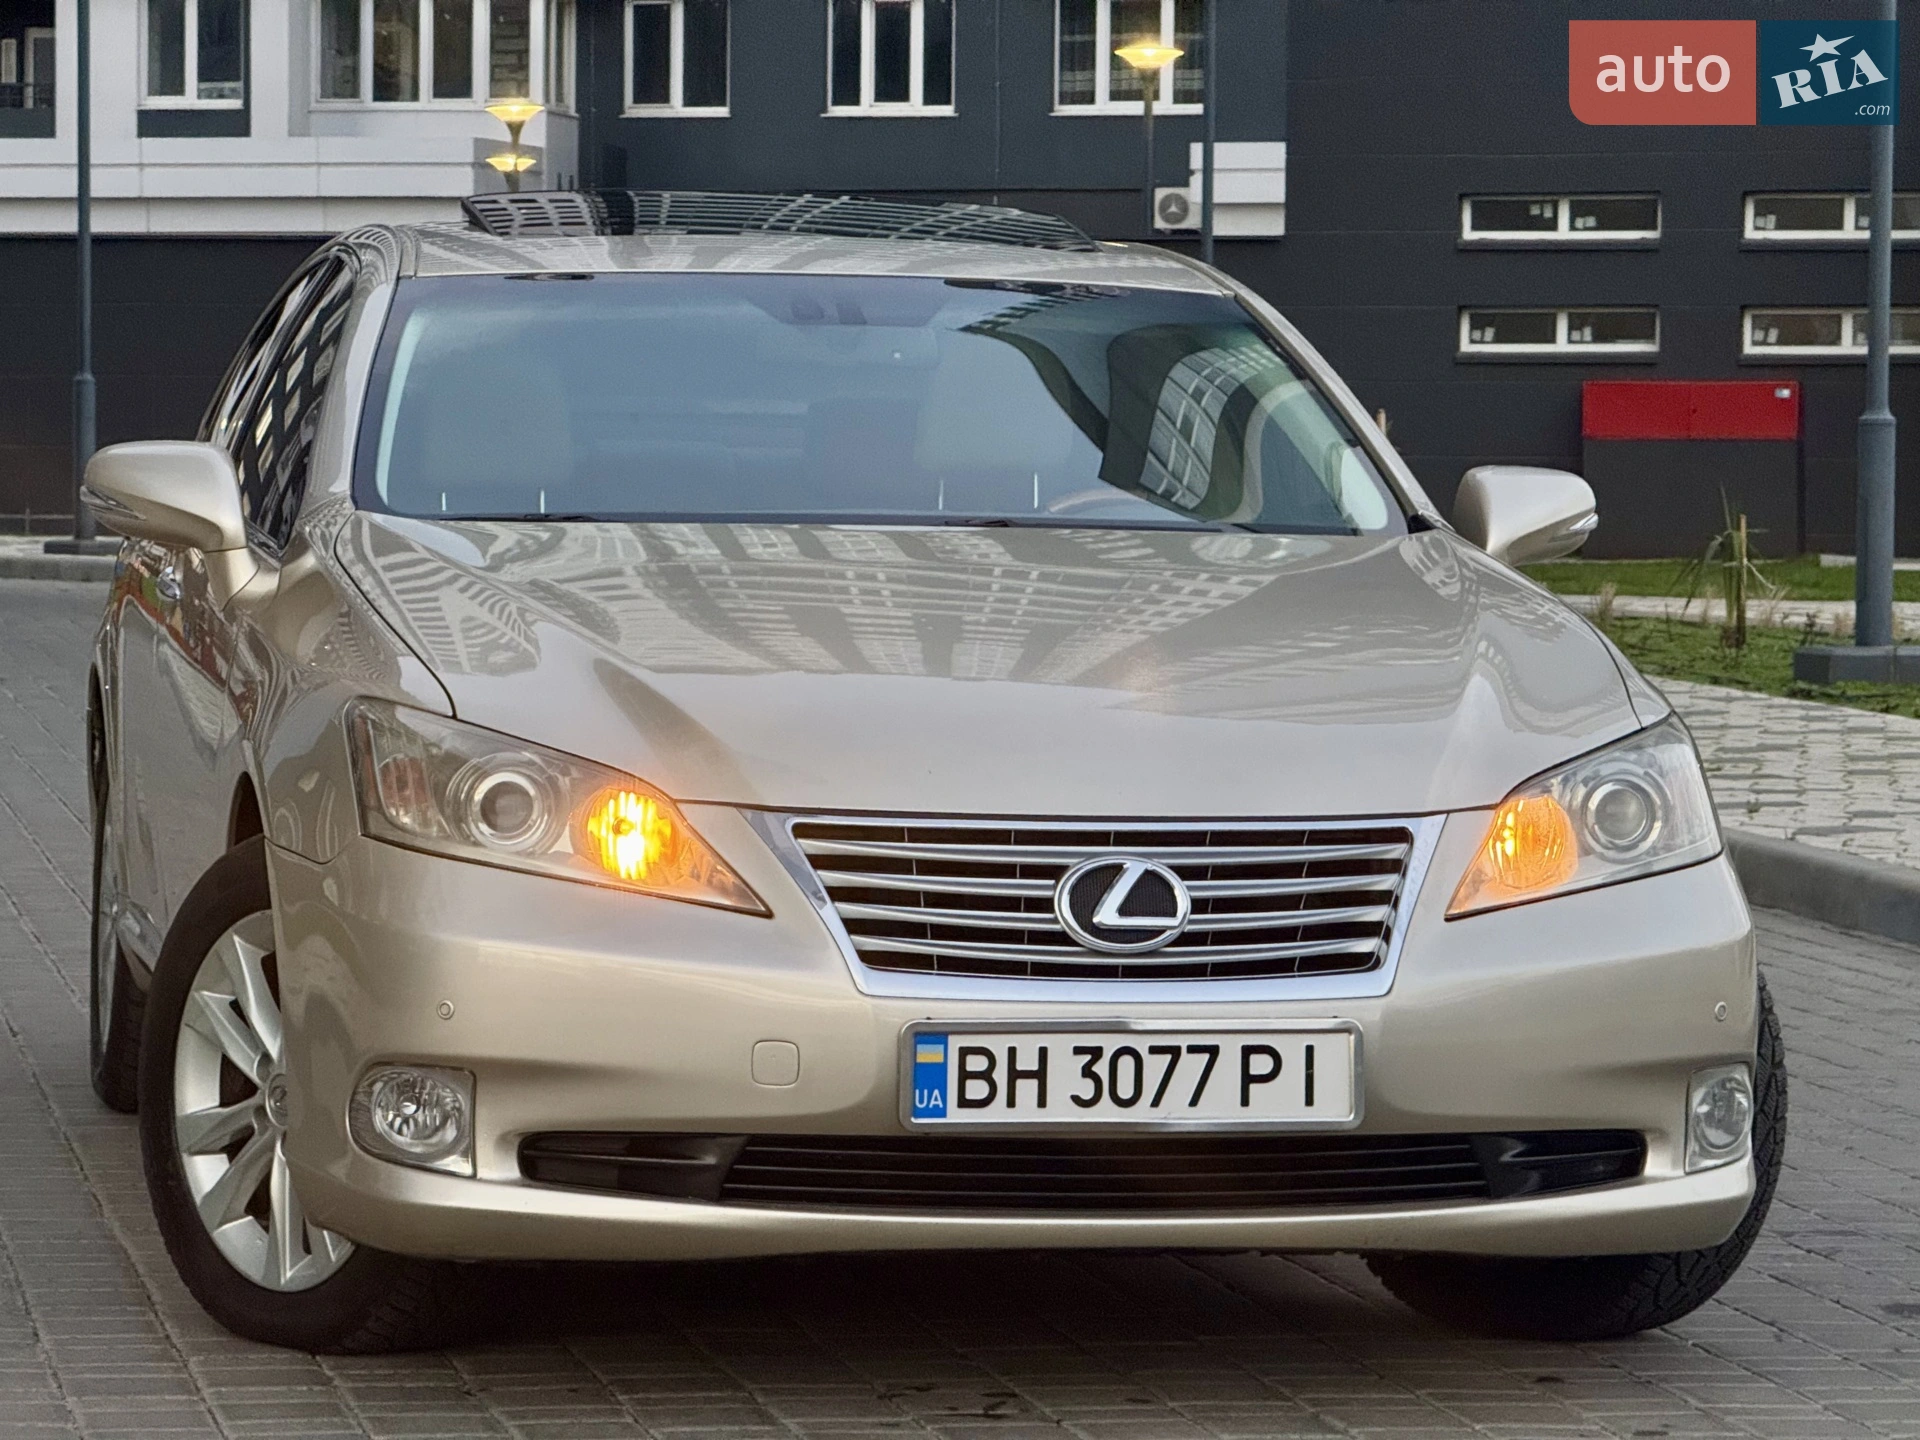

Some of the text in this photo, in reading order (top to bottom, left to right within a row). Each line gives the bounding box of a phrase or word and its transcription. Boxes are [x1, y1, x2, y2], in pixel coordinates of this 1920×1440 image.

[957, 1046, 1049, 1108] BH
[1070, 1045, 1220, 1108] 3077
[915, 1089, 944, 1109] UA
